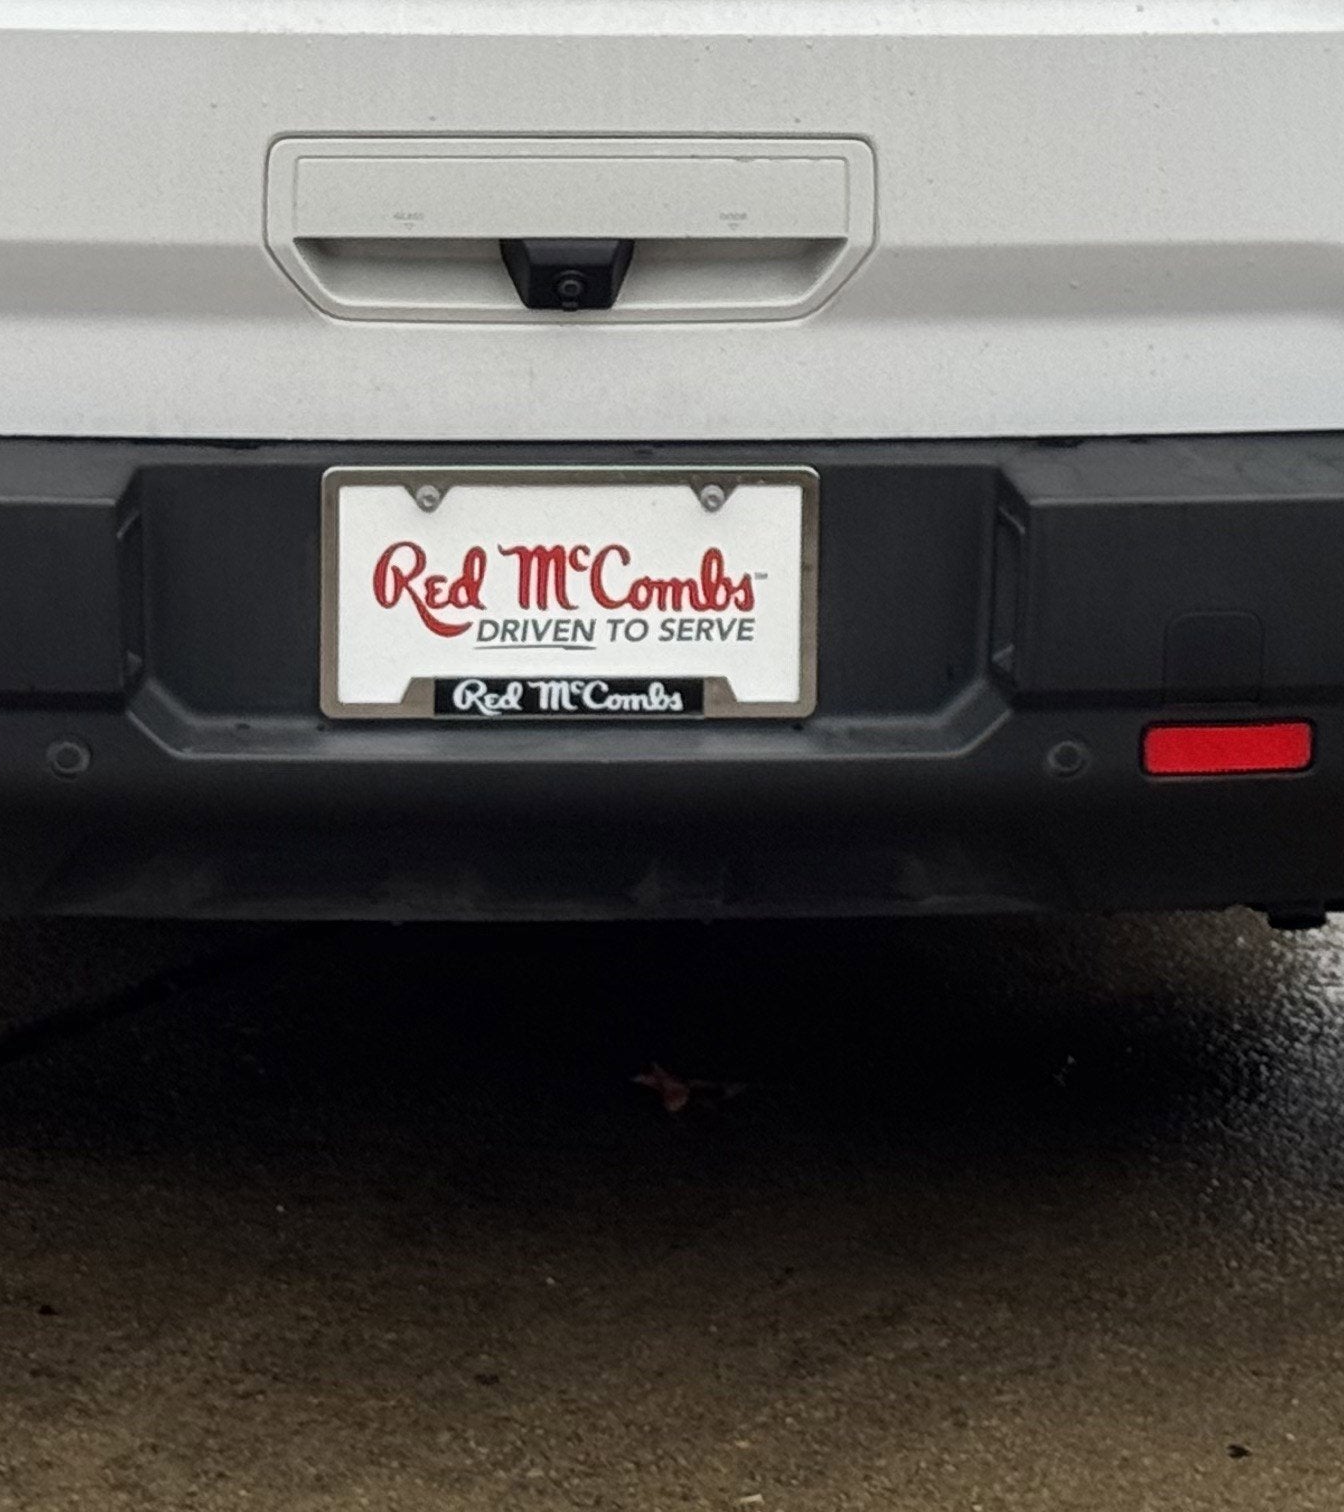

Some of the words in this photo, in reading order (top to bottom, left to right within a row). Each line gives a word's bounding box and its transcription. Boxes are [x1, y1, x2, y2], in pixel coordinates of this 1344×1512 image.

[371, 540, 488, 638] Red
[497, 543, 756, 613] McCombs
[475, 618, 597, 643] DRIVEN
[606, 617, 650, 643] TO
[658, 617, 756, 643] SERVE
[452, 678, 523, 716] Red
[527, 679, 684, 712] McCombs
